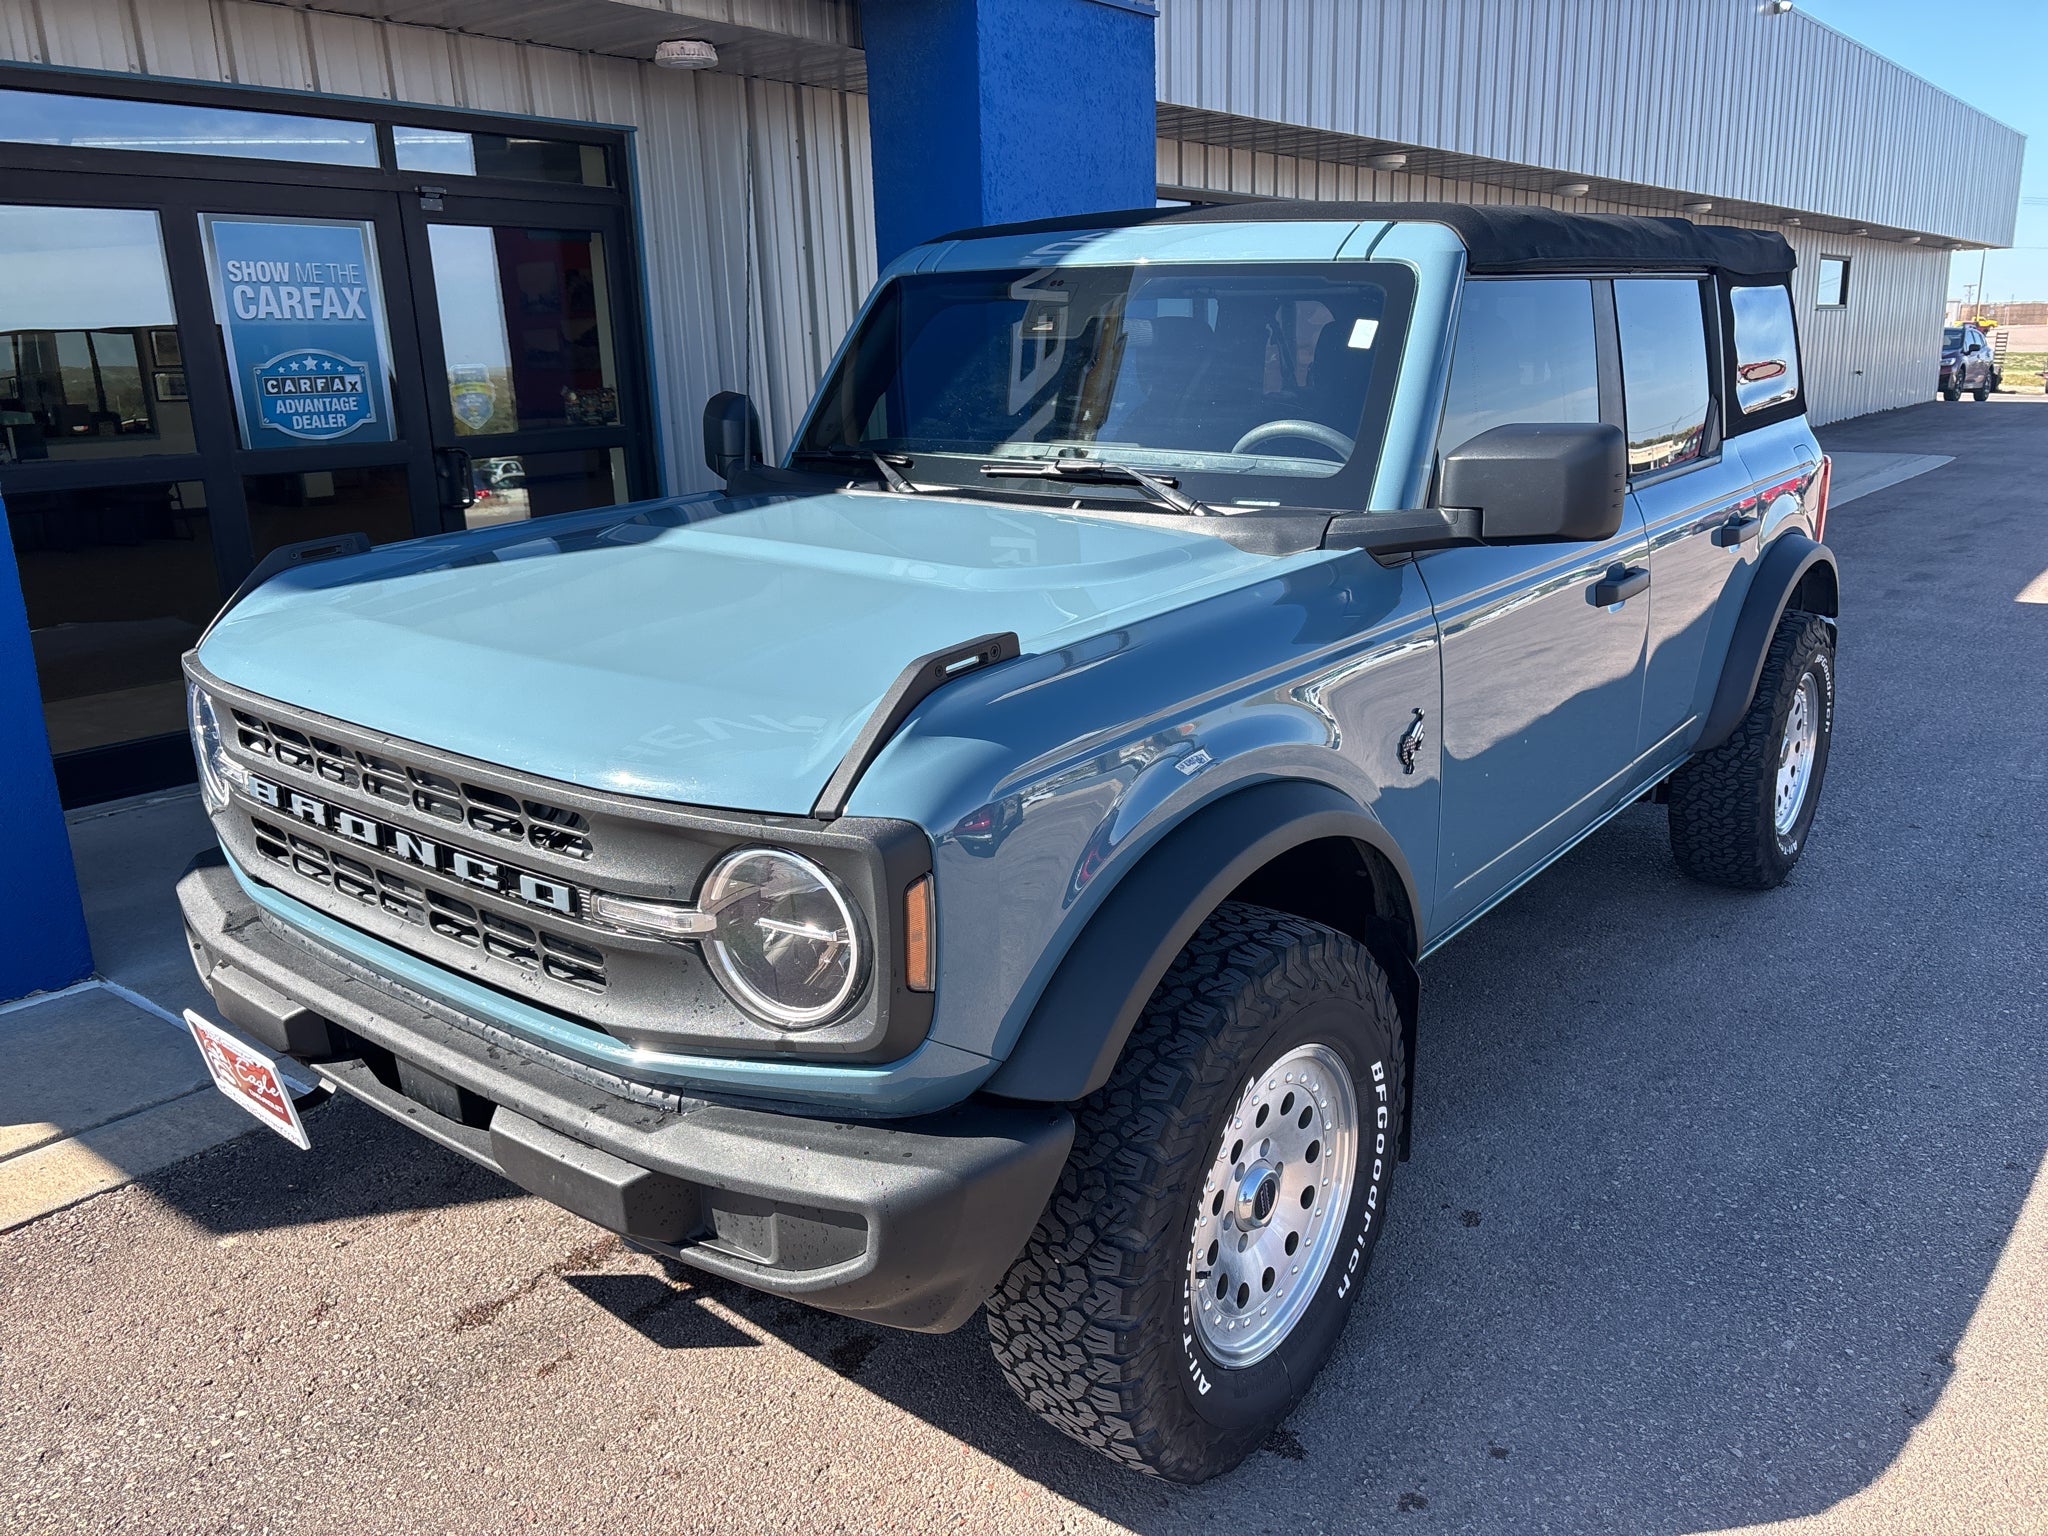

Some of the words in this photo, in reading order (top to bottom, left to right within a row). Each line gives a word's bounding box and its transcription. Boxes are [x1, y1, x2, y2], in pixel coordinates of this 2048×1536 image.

[227, 260, 289, 283] SHOW
[295, 262, 322, 283] ME
[326, 264, 361, 284] THE
[233, 285, 367, 320] CARFAX
[266, 378, 361, 393] CARFAX
[276, 397, 358, 414] ADVANTAGE
[292, 414, 347, 429] DEALER
[250, 774, 576, 914] BRONCO
[235, 1057, 280, 1097] Eagle
[1337, 1060, 1388, 1299] BFGoodrich
